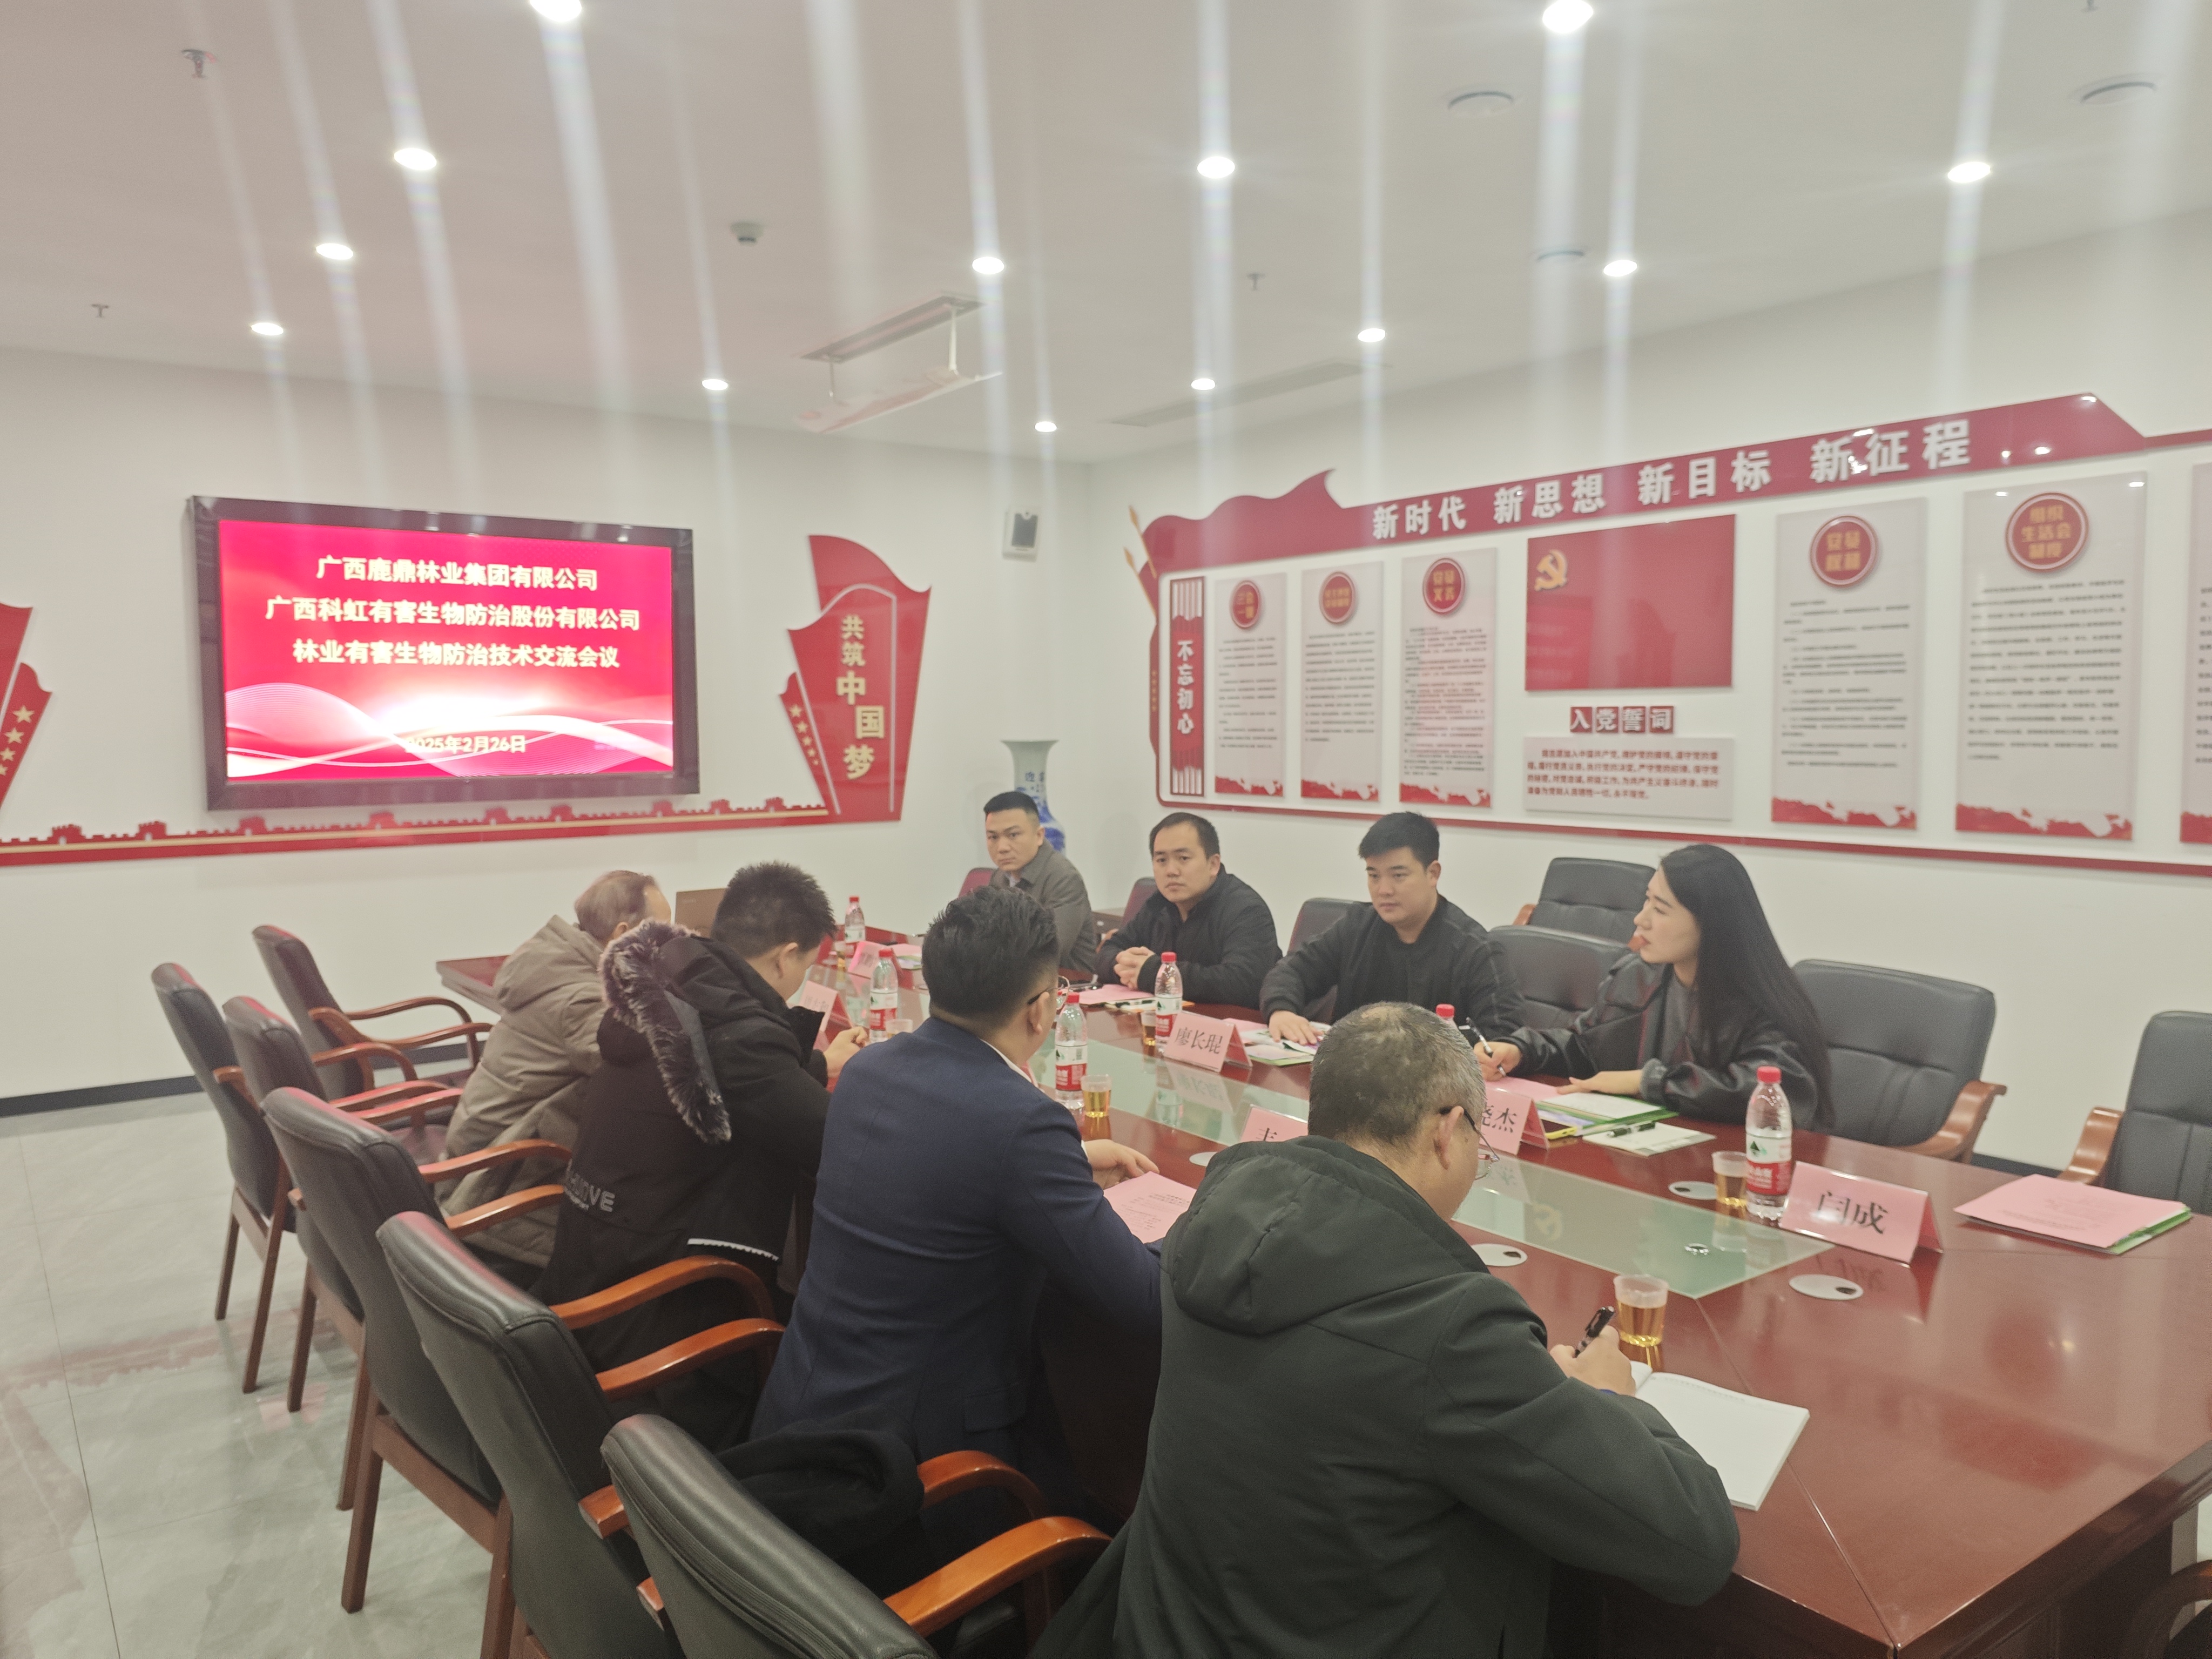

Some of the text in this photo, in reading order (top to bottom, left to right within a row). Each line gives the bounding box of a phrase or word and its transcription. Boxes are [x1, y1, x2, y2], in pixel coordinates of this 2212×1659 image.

[1373, 419, 1971, 539] 新时代 新思想 新目标 新征程
[316, 556, 598, 591] 广西鹿鼎林业集团有限公司
[265, 596, 640, 631] 广西科虹有害生物防治股份有限公司
[293, 639, 621, 668] 林业有害生物防治技术交流会议
[836, 615, 885, 780] 共筑中国梦
[1177, 640, 1194, 734] 不忘初心
[1571, 709, 1672, 732] 入党誓词
[405, 735, 526, 753] 2025年2月26日
